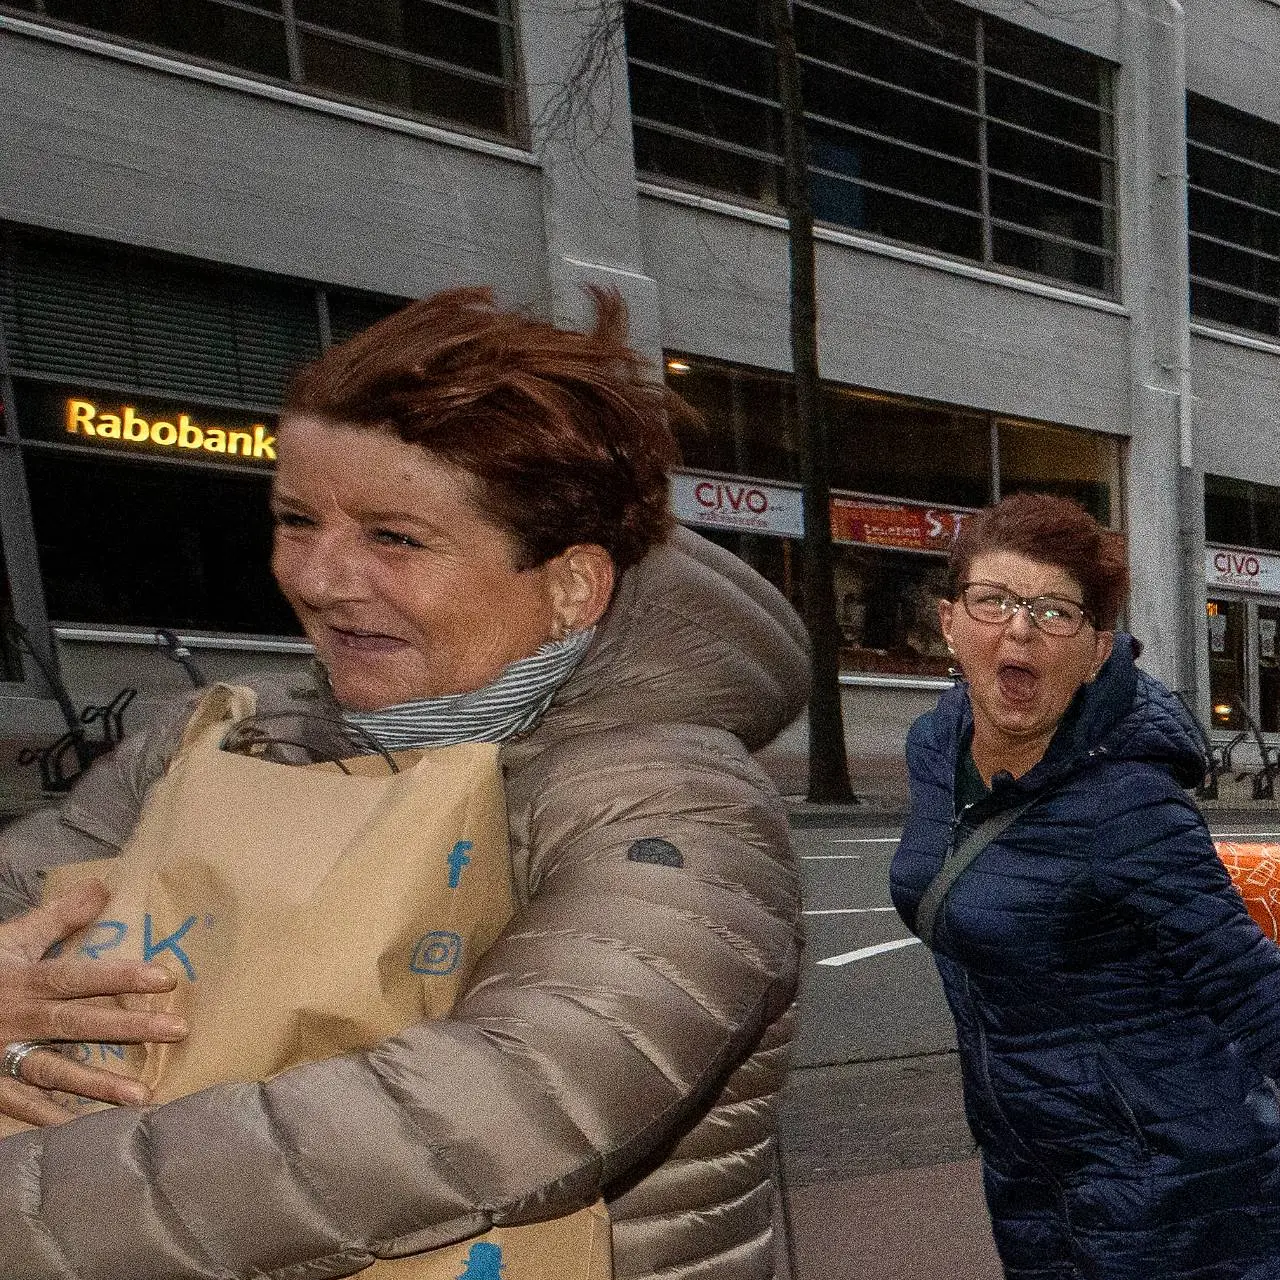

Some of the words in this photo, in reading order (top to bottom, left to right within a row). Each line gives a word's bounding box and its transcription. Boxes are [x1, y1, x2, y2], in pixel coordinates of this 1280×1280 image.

[66, 397, 277, 460] Rabobank
[694, 481, 769, 514] CIVO
[1213, 552, 1260, 577] CIVO
